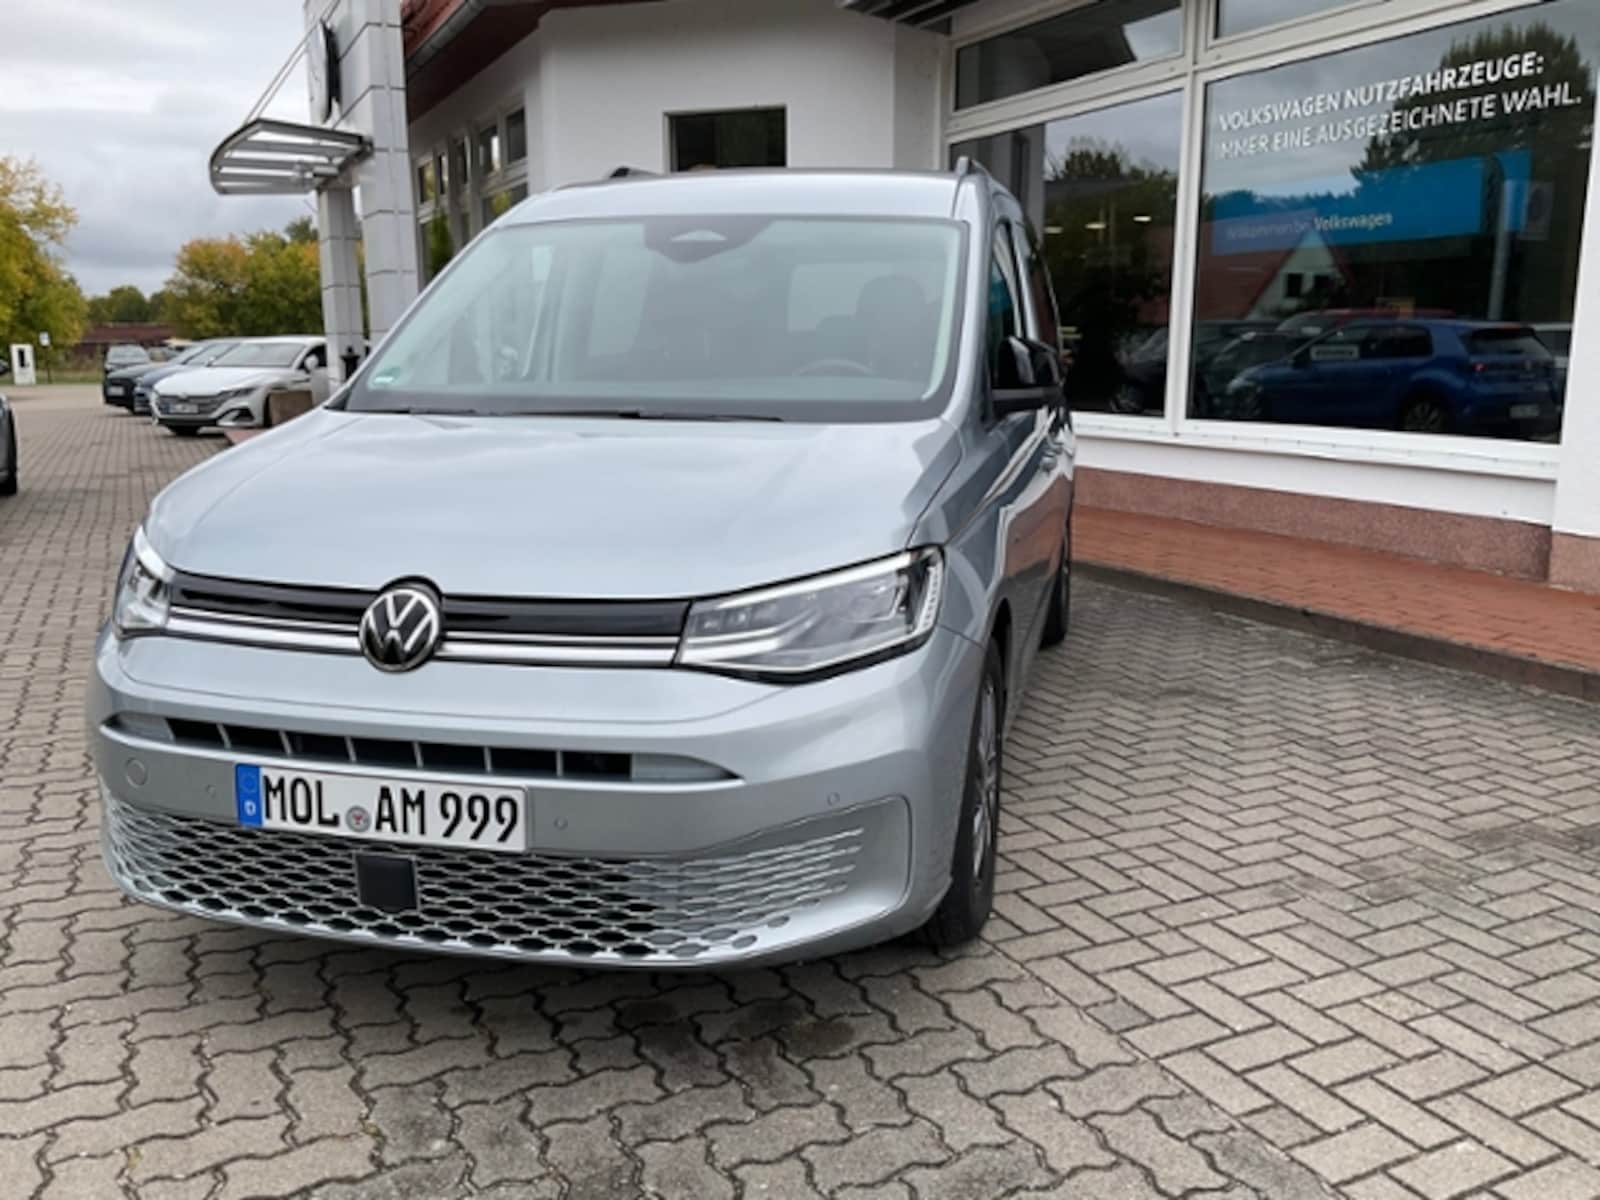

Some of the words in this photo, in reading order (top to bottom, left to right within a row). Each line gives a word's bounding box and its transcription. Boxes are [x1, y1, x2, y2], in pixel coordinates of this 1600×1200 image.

[1219, 91, 1341, 131] VOLKSWAGEN
[1343, 51, 1545, 109] NUTZFAHRZEUGE:
[1273, 126, 1312, 152] EINE
[1315, 94, 1497, 145] AUSGEZEICHNETE
[1502, 81, 1582, 114] WAHL.
[262, 774, 340, 828] MOL
[374, 786, 427, 836] AM
[438, 792, 519, 843] 999
